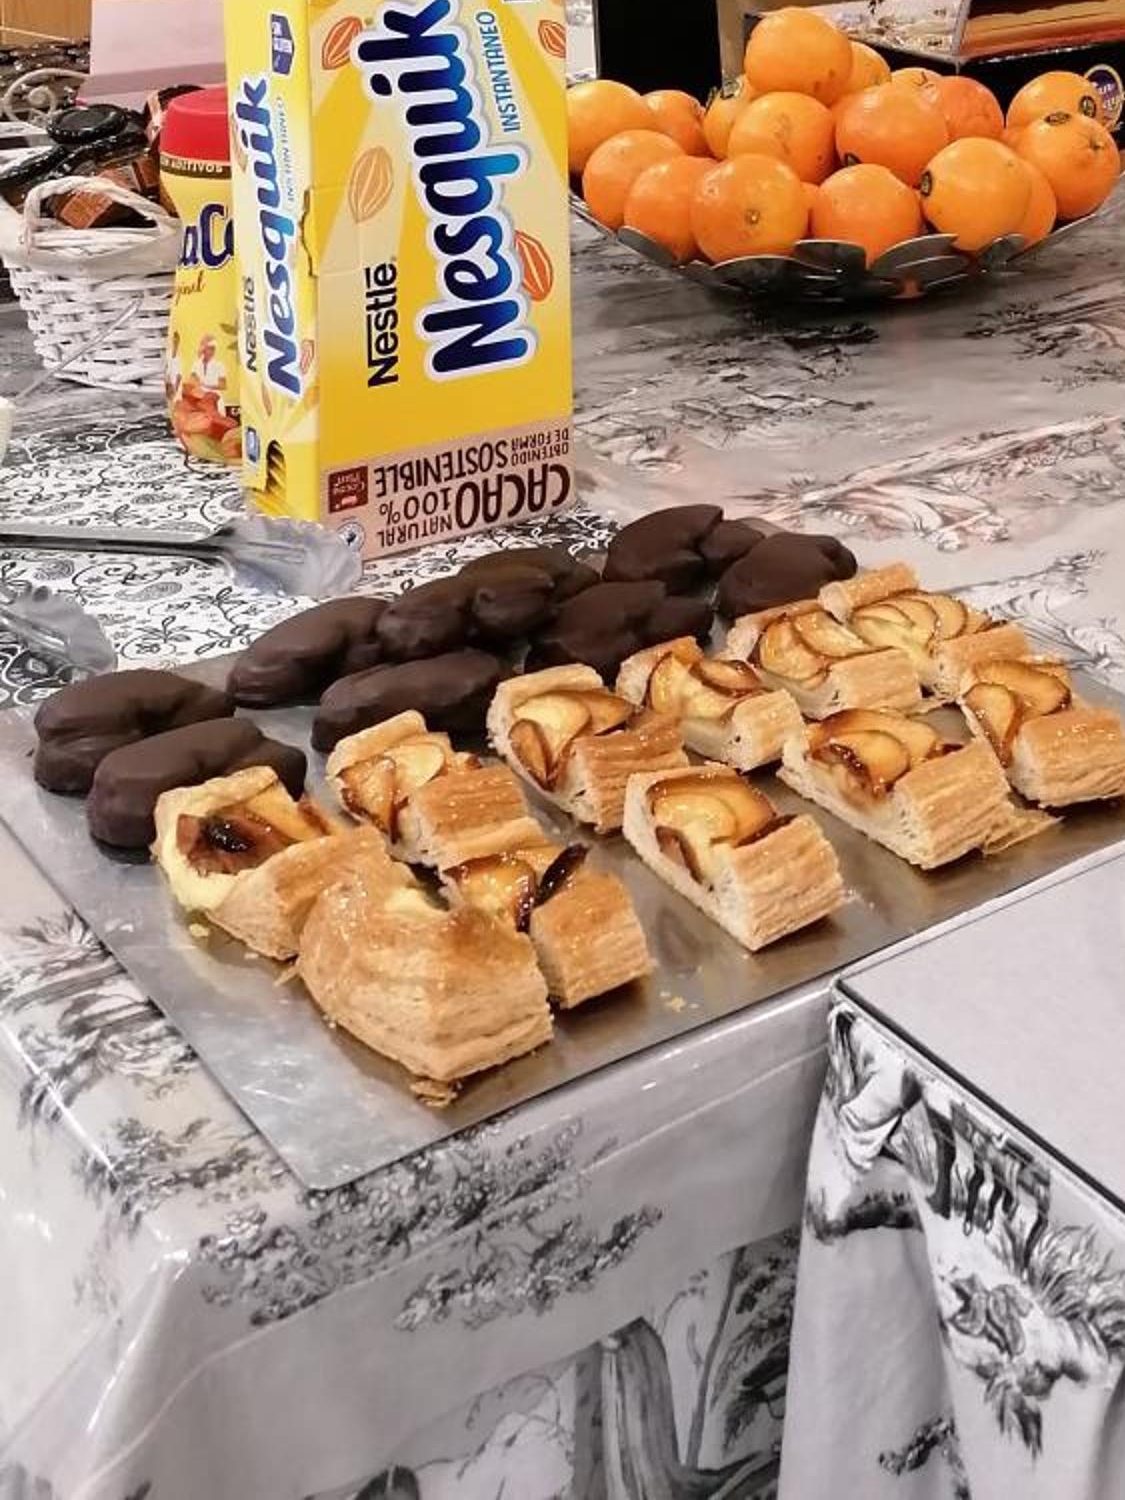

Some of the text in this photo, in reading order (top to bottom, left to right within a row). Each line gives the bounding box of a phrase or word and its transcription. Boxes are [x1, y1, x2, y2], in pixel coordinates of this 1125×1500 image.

[235, 77, 301, 395] Nesquik
[511, 427, 570, 451] DE FORMA
[511, 441, 570, 466] OBTENIDO
[374, 439, 508, 498] SOSTENIBLE
[377, 463, 571, 548] CACAO NATURAL
[379, 487, 452, 525] 100%
